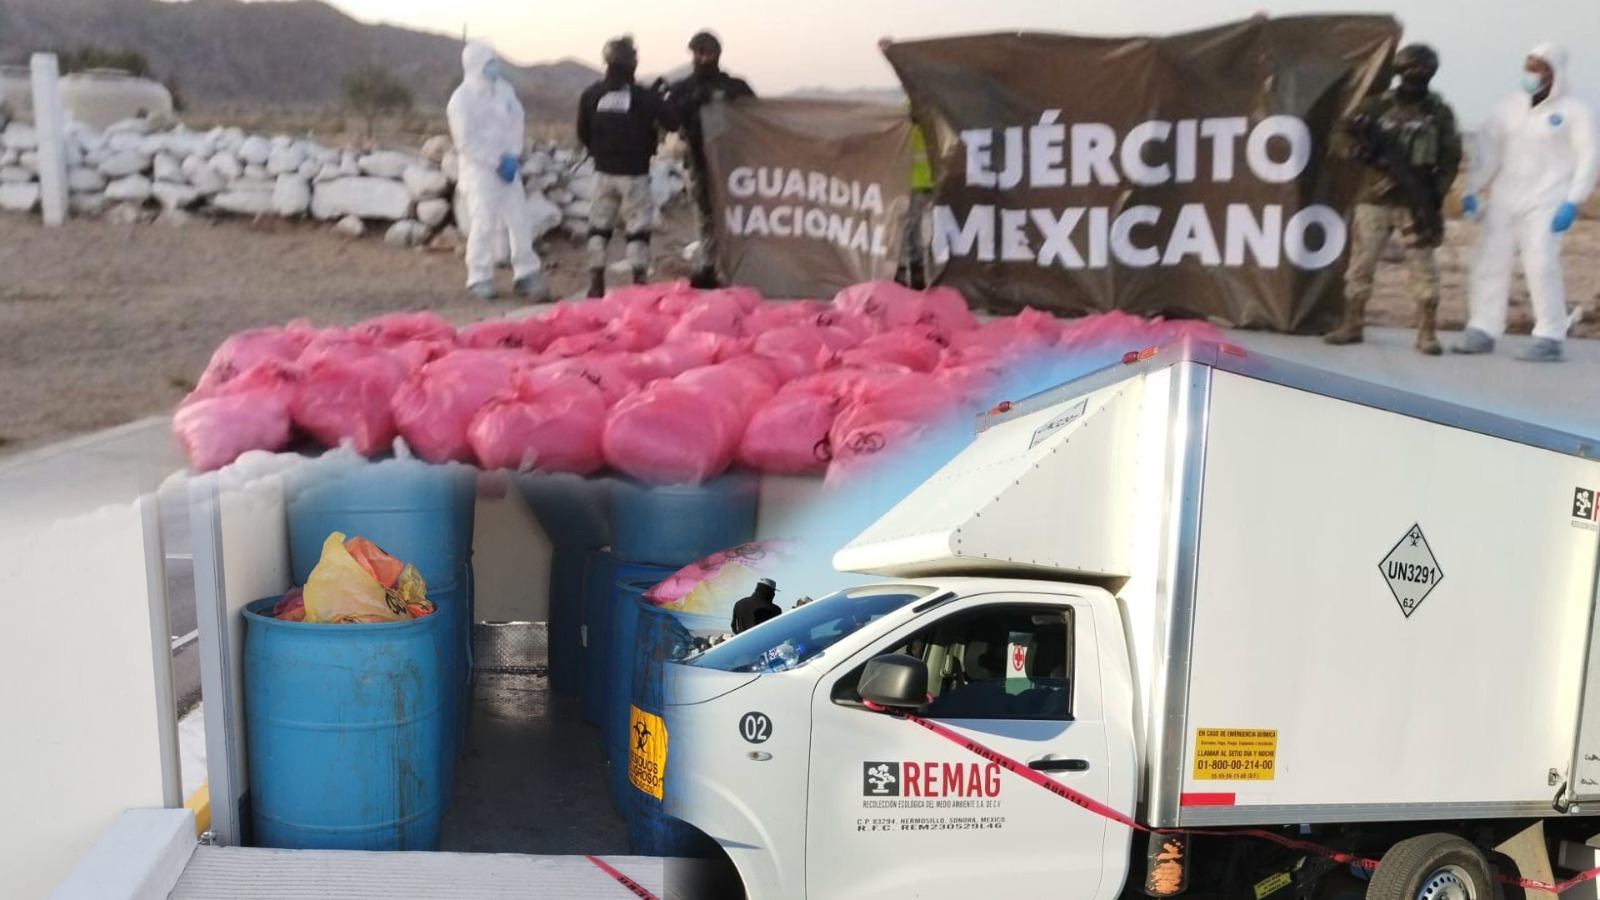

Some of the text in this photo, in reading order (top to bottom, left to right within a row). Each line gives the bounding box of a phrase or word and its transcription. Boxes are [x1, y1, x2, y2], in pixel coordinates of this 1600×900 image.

[961, 108, 1312, 188] EJÉRCITO
[727, 165, 884, 216] GUARDIA
[724, 204, 888, 256] NACIONAL
[931, 203, 1348, 270] MEXICANO
[1388, 560, 1436, 584] UN3291
[745, 715, 767, 740] 02
[903, 761, 1001, 798] REMAG
[1198, 760, 1273, 769] 01-800-00-214-00
